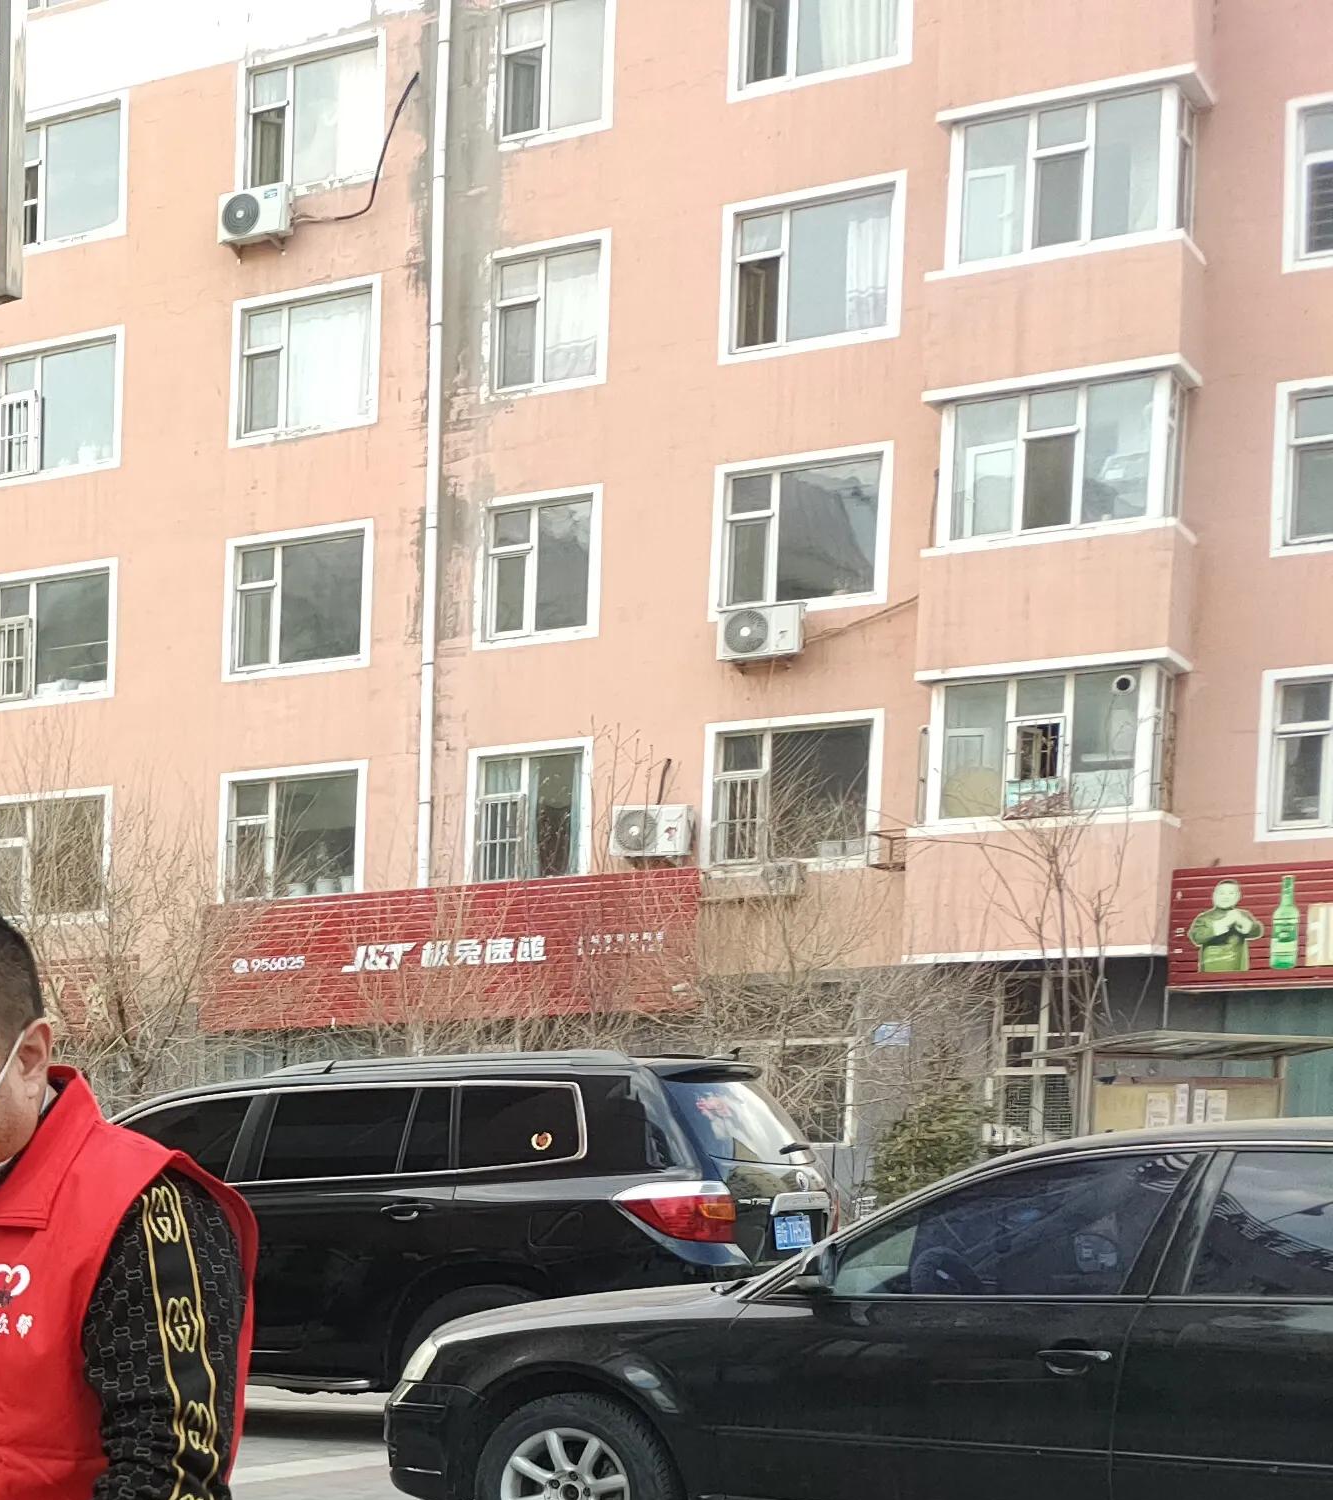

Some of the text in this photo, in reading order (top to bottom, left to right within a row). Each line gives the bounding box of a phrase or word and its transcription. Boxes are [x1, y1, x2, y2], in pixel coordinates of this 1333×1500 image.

[251, 955, 306, 972] 956025
[421, 935, 546, 968] 极兔速递
